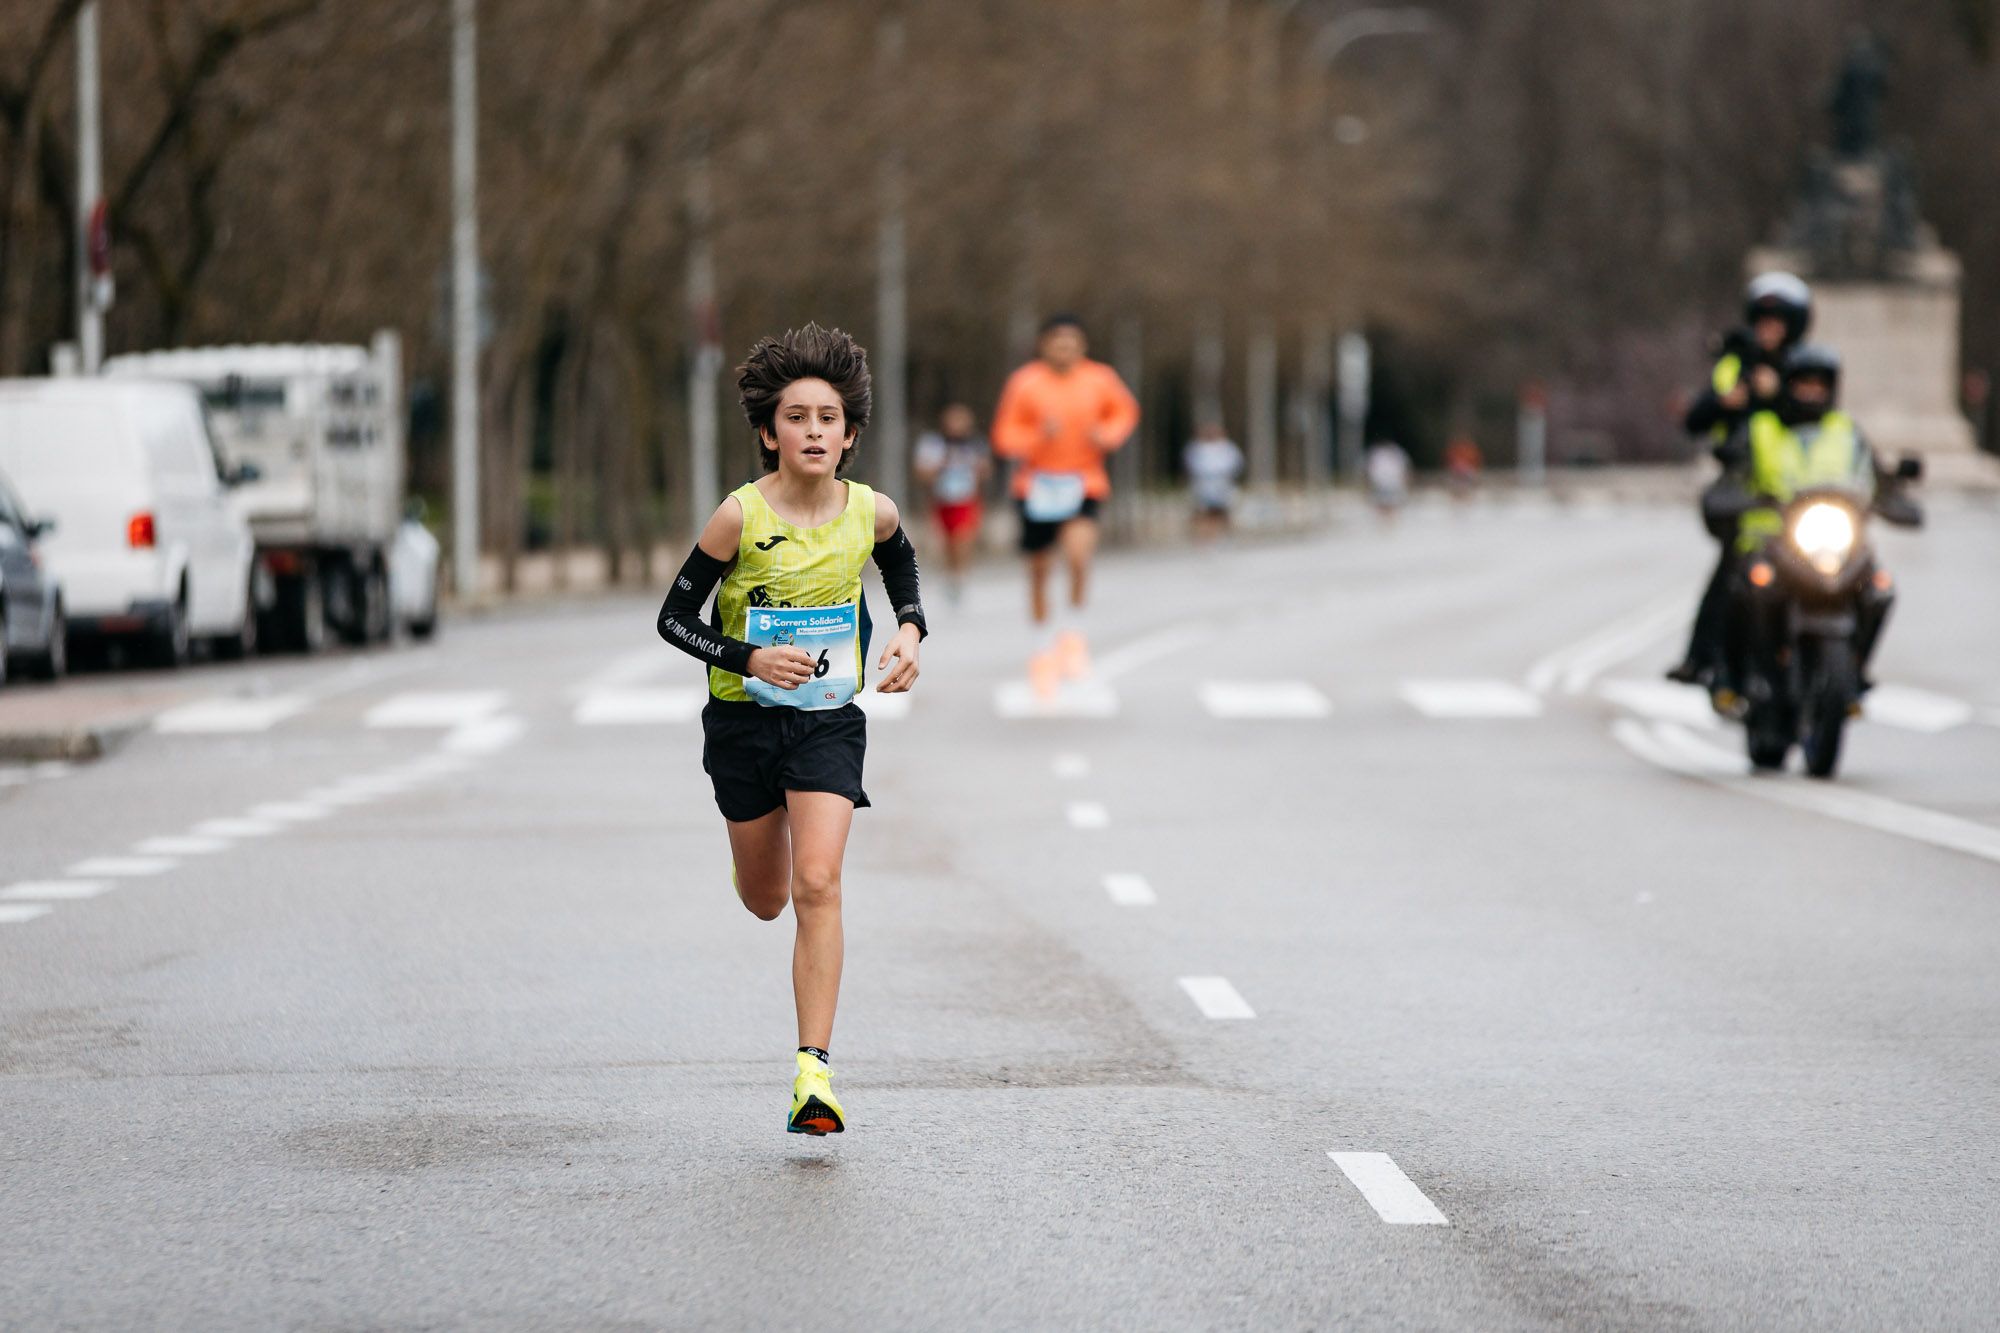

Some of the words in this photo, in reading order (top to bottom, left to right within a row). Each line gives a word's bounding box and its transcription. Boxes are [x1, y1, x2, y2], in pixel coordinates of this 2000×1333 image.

[773, 618, 808, 627] Carrera
[809, 616, 844, 626] Solidaria
[824, 692, 837, 700] CSL
